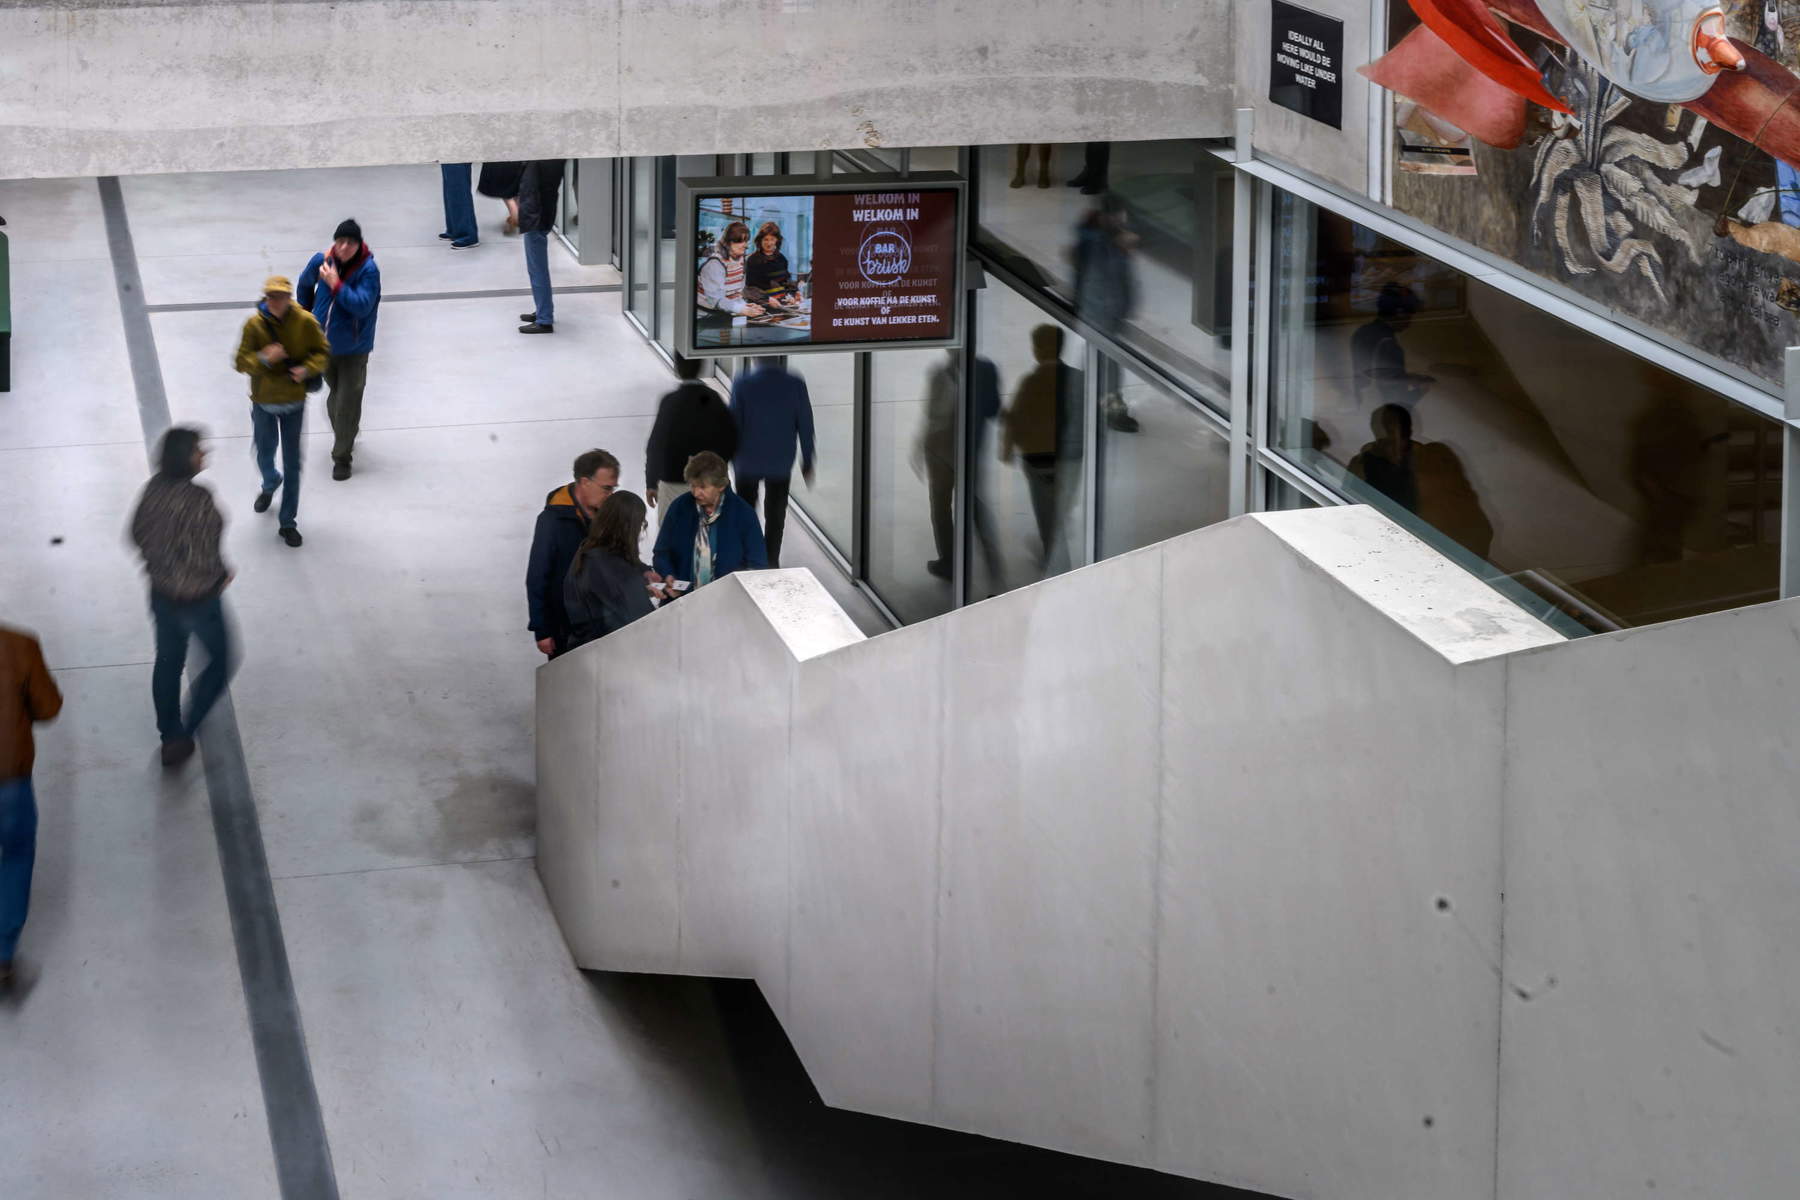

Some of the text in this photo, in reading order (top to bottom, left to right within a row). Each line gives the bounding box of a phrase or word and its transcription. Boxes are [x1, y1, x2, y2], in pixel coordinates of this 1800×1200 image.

[1288, 30, 1325, 51] IDEALLY ALL
[1282, 42, 1331, 68] HERE WOULD BE
[1277, 53, 1336, 83] MOVING LIKE UNDER
[1295, 73, 1316, 89] WATER
[854, 193, 920, 205] WELKOM IN
[853, 208, 919, 222] WELKOM IN
[875, 243, 895, 254] BAR
[837, 297, 859, 306] VOOR
[860, 296, 885, 305] KOFFIE
[900, 295, 909, 304] DE
[881, 306, 891, 315] OF
[832, 314, 940, 327] DE KUNST VAN LEKKER ETEN.
